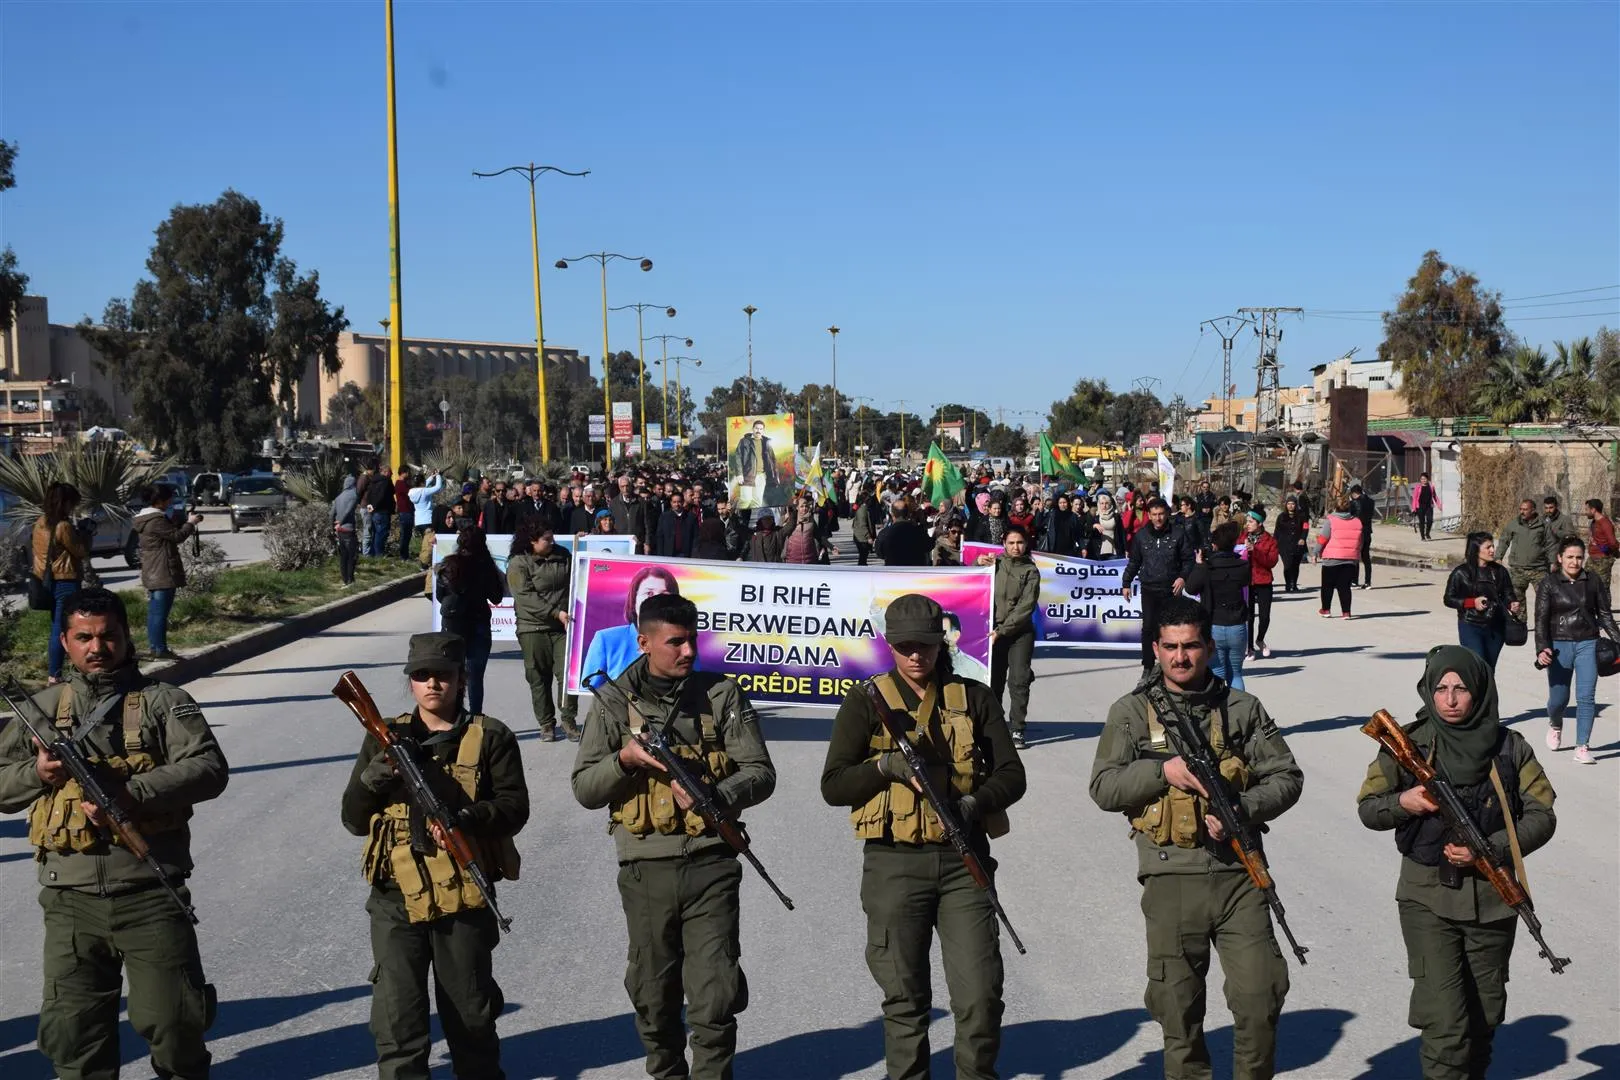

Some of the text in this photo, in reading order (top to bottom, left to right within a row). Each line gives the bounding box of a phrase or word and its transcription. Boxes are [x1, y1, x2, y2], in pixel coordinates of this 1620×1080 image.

[1055, 563, 1119, 580] مقاومة
[740, 583, 831, 606] BI RIHÊ
[1070, 584, 1138, 600] اسجون
[696, 611, 876, 637] BERXWEDANA
[1047, 604, 1143, 623] حطم العزلة
[725, 643, 840, 667] ZINDANA
[723, 672, 812, 694] CRÊDE
